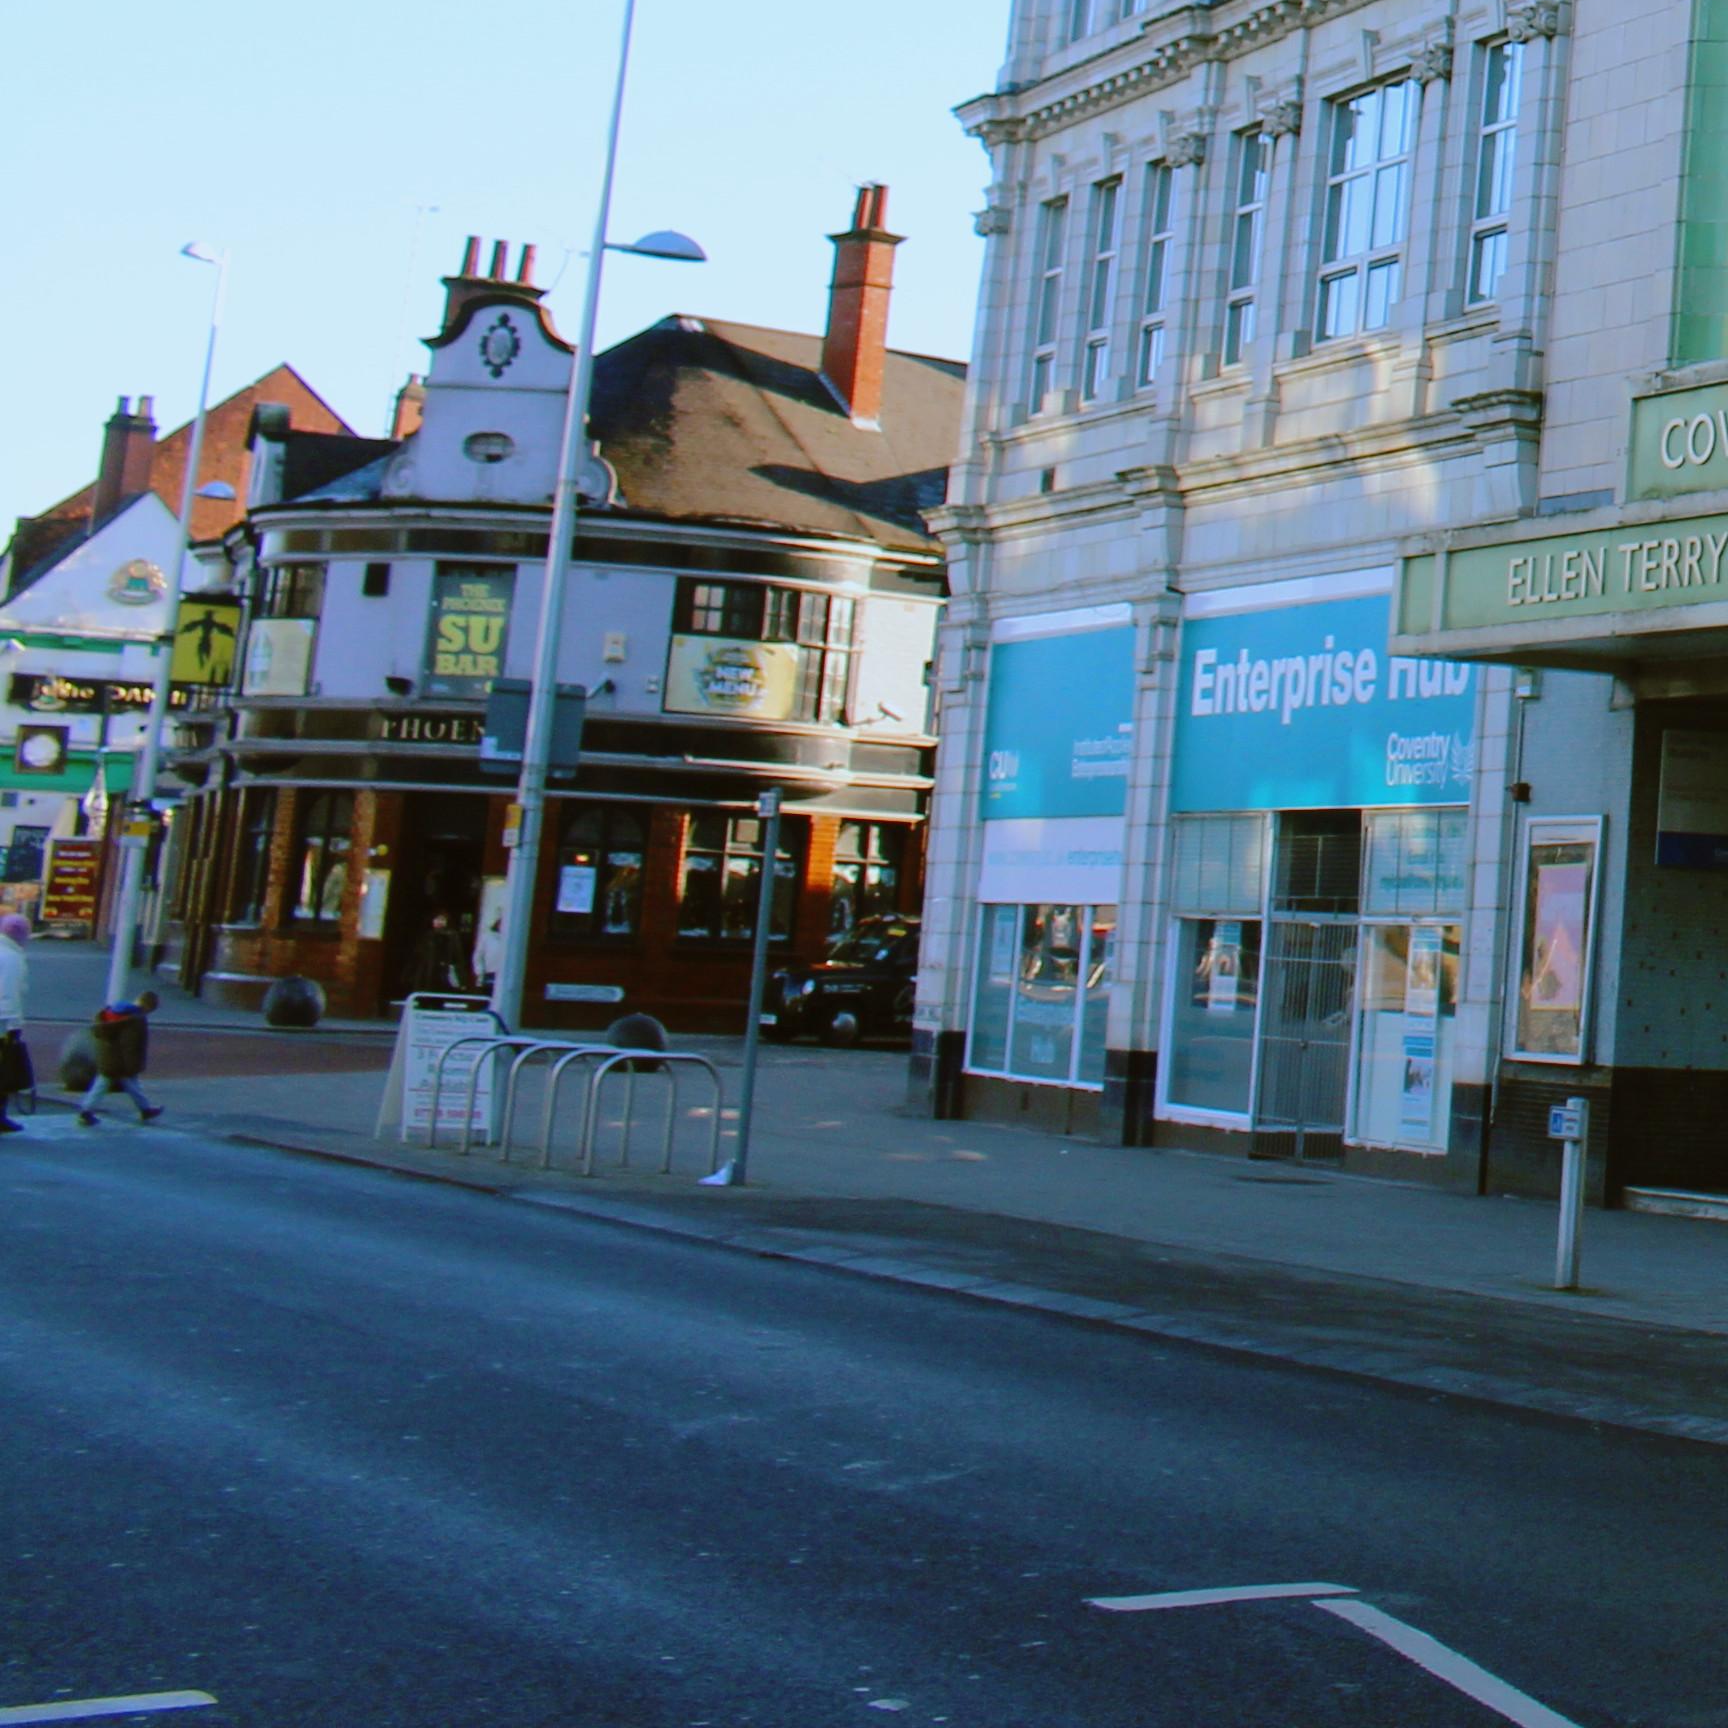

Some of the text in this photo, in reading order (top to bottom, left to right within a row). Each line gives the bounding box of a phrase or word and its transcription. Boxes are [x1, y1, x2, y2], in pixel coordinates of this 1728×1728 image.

[1506, 549, 1604, 607] ELLEN
[437, 614, 505, 653] SU
[434, 654, 498, 676] BAR
[1191, 634, 1379, 725] Enterprise
[1386, 732, 1451, 763] Coventry
[1386, 761, 1449, 790] University
